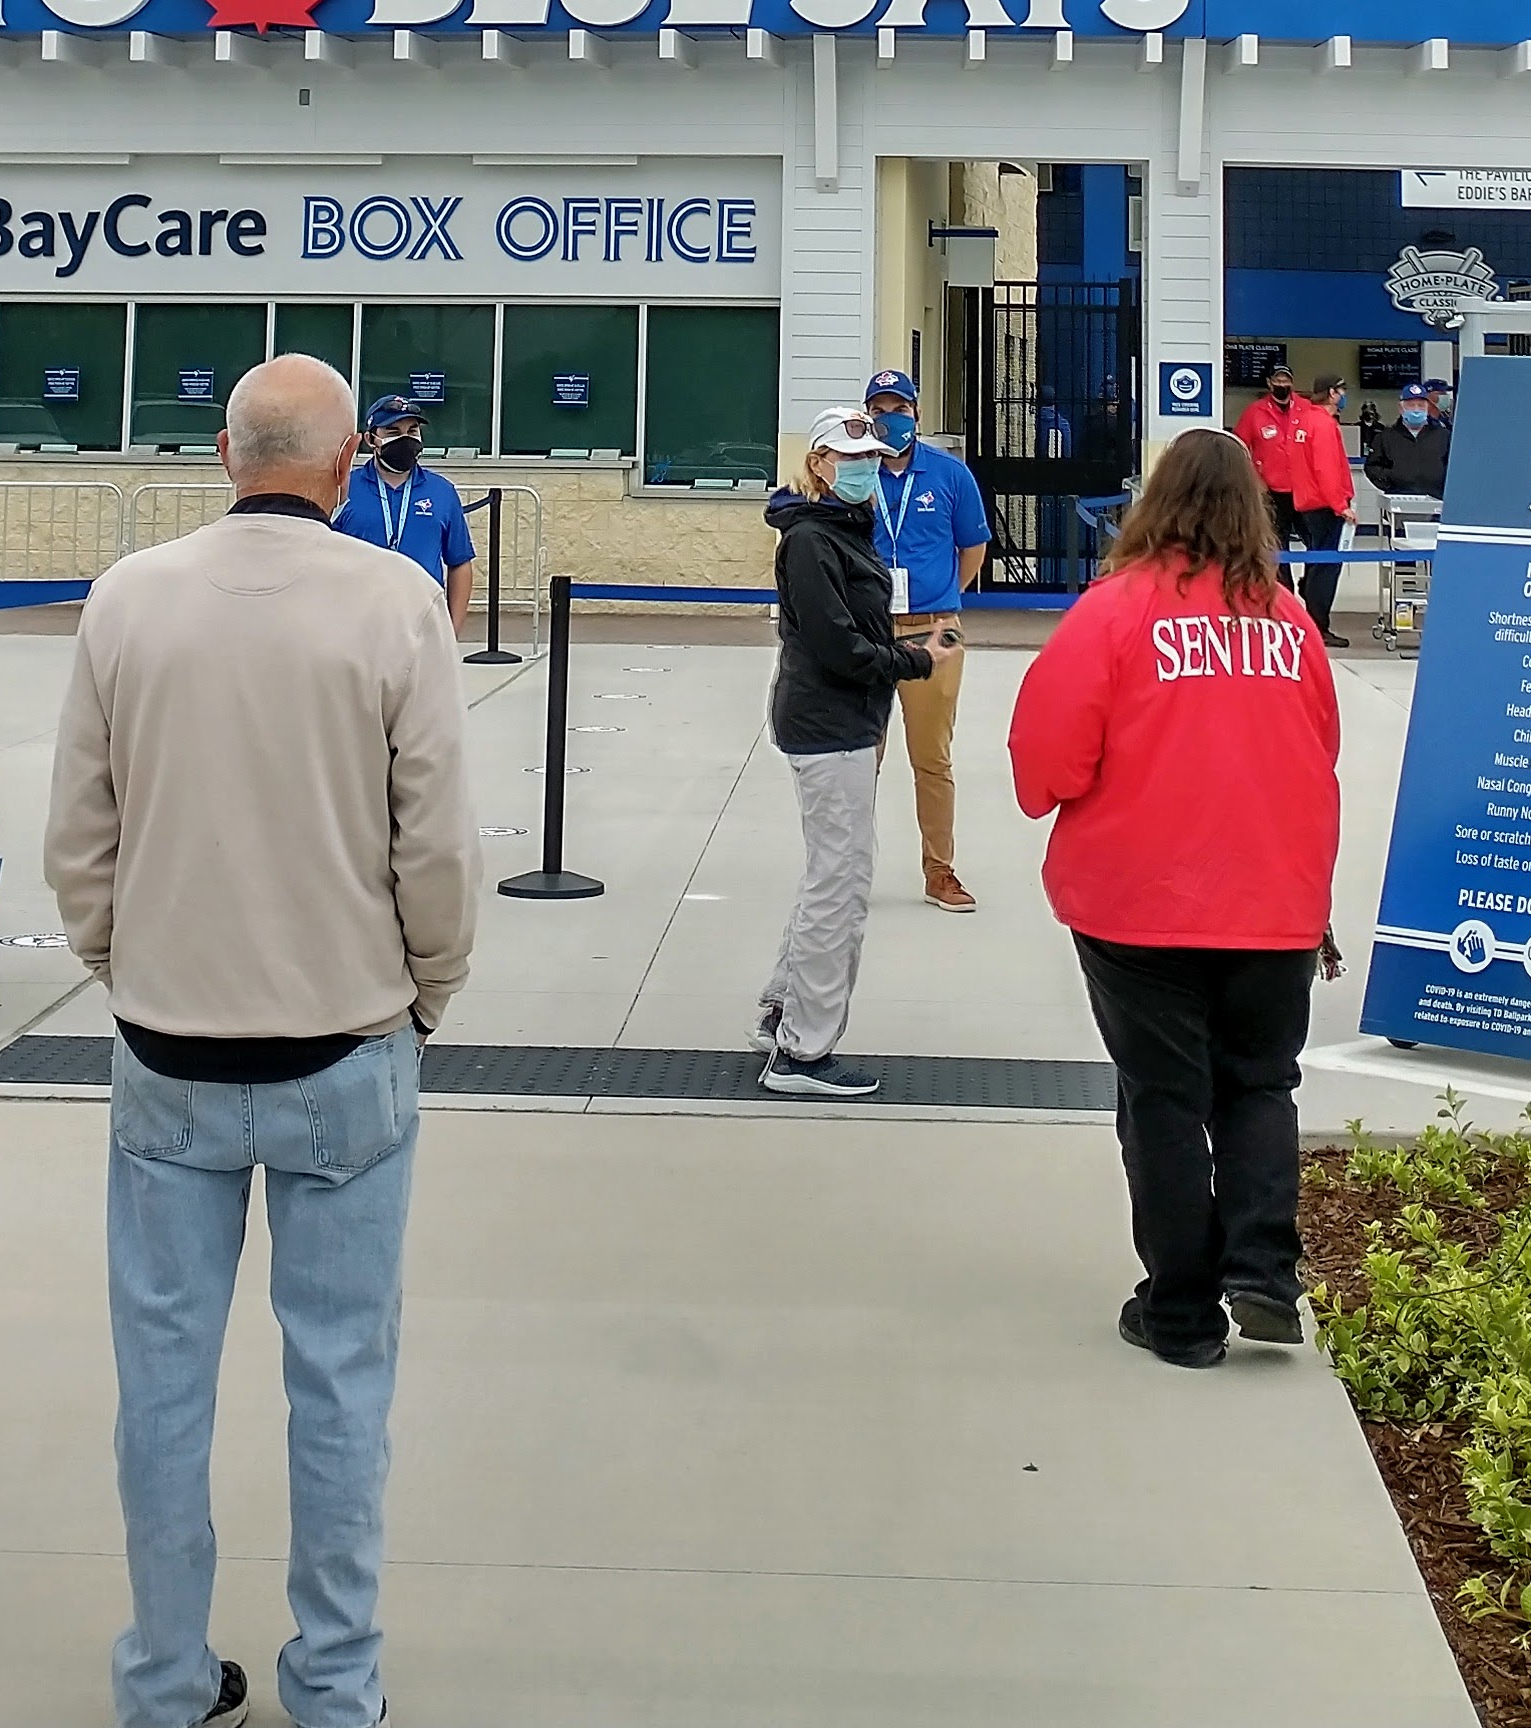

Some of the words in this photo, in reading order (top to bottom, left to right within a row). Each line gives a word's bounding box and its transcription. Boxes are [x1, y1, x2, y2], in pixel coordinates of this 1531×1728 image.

[1458, 186, 1506, 200] EDDIE'S
[301, 195, 464, 261] BOX
[494, 195, 757, 264] OFFICE
[1152, 616, 1306, 681] SENTRY
[1458, 889, 1513, 911] PLEASE
